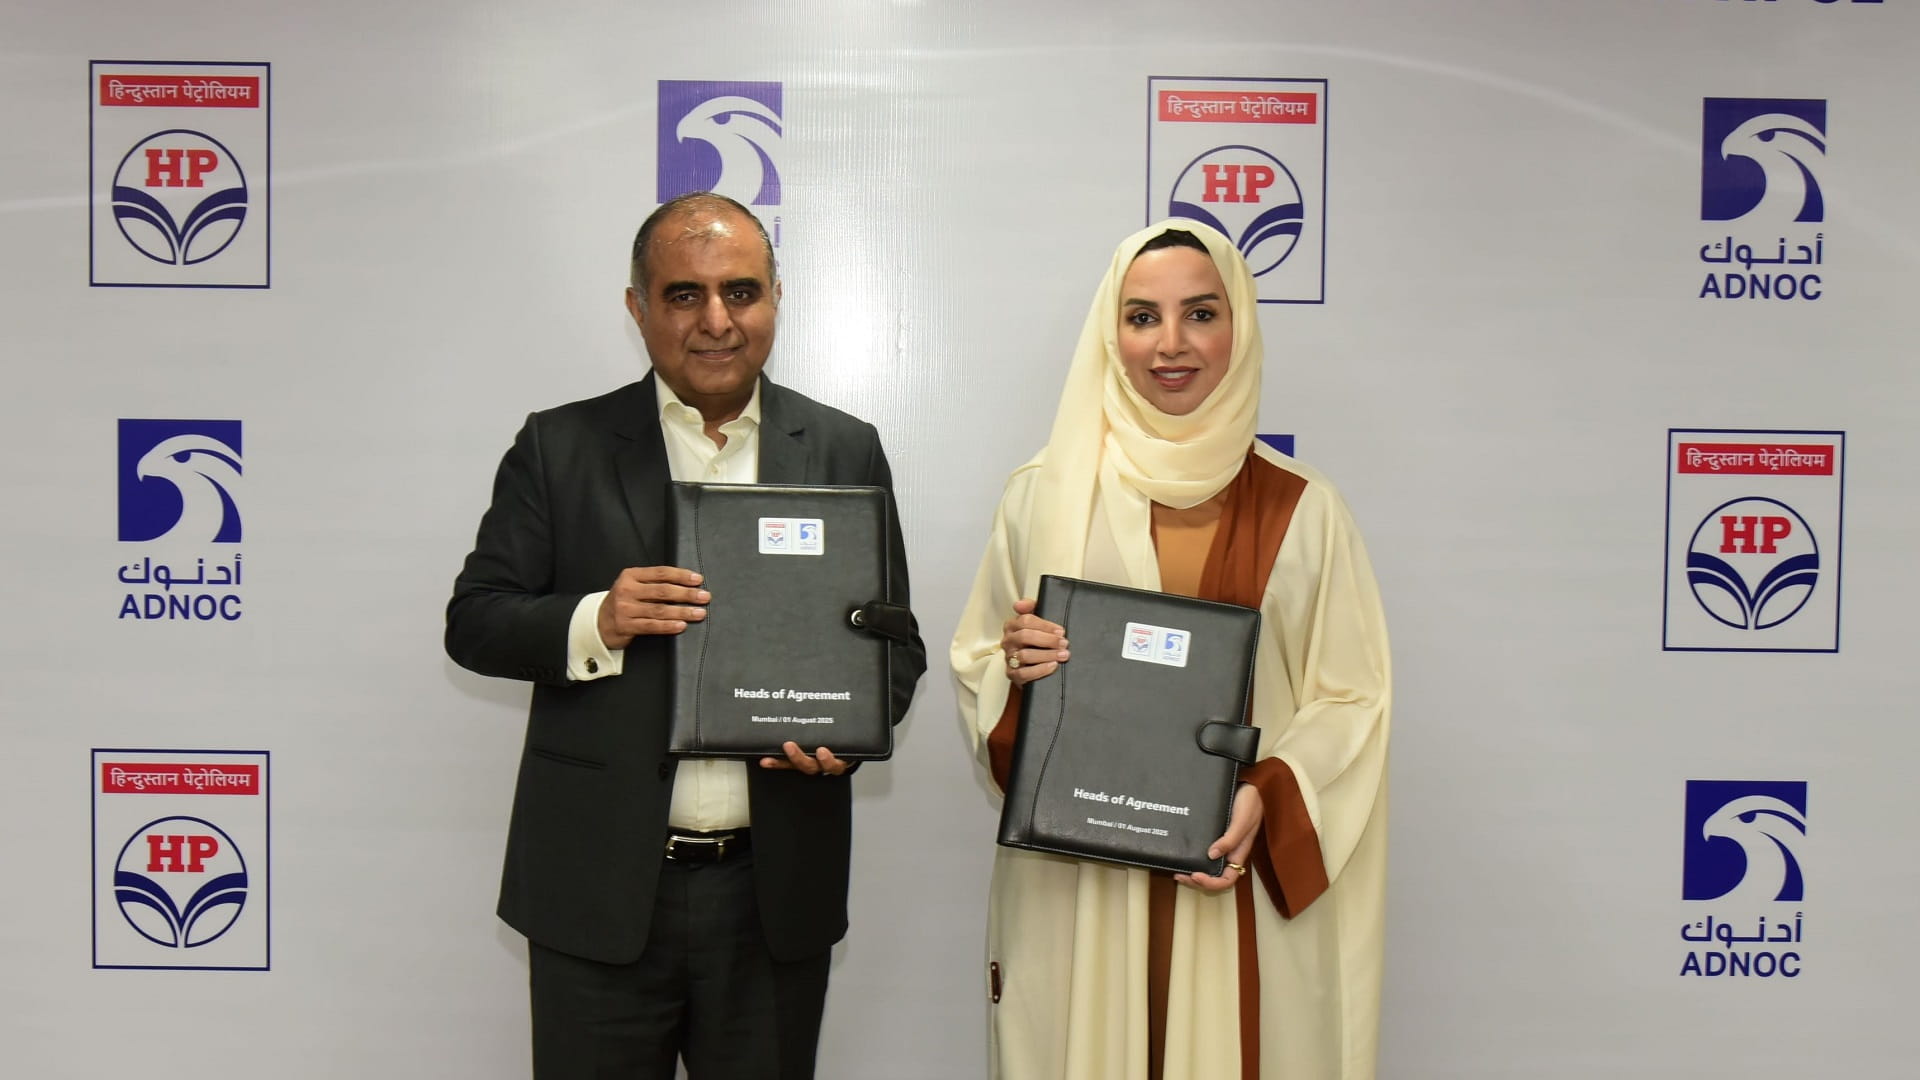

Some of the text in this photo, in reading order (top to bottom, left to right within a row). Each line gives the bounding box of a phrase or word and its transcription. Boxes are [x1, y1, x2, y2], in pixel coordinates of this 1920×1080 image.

[108, 79, 252, 102] हिन्दुस्तान पेट्रोलियम
[1167, 95, 1309, 118] हिन्दुस्तान पेट्रोलियम
[145, 149, 219, 187] HP
[1202, 164, 1275, 203] HP
[1699, 232, 1824, 271] أدنوك
[1699, 273, 1822, 300] ADNOC
[1686, 447, 1826, 470] हिन्दुस्तान पेट्रोलियम
[1720, 515, 1792, 554] HP
[118, 553, 242, 592] أدنوك
[118, 594, 242, 621] ADNOC
[734, 688, 851, 702] Heads of Agreement
[792, 717, 817, 725] August
[110, 767, 252, 790] हिन्दुस्तान पेट्रोलियम
[1073, 787, 1191, 816] Heads of Agreement
[1086, 817, 1113, 828] Mumbai
[1117, 822, 1127, 830] 01
[1127, 824, 1152, 834] August
[146, 835, 219, 872] HP
[1680, 911, 1804, 949] أدنوك
[1679, 951, 1801, 978] ADNOC
